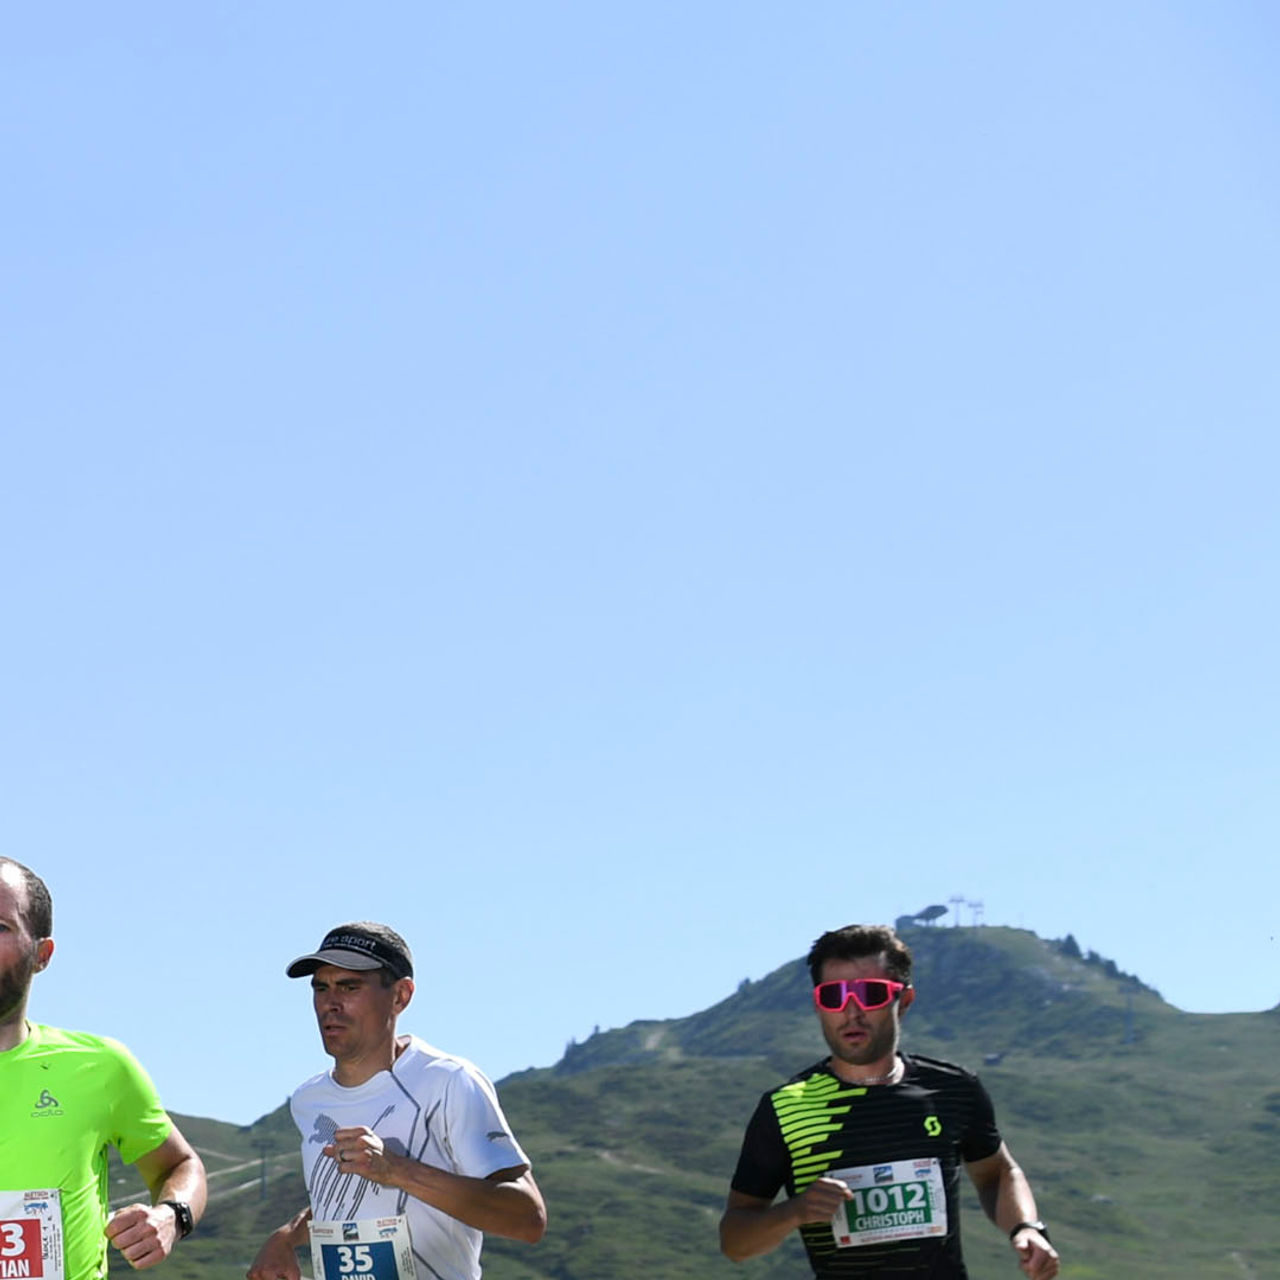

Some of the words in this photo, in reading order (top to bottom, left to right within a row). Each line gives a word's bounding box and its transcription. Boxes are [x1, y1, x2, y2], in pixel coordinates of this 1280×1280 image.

[853, 1183, 927, 1215] 1012
[855, 1210, 925, 1231] CHRISTOPH
[337, 1245, 374, 1273] 35
